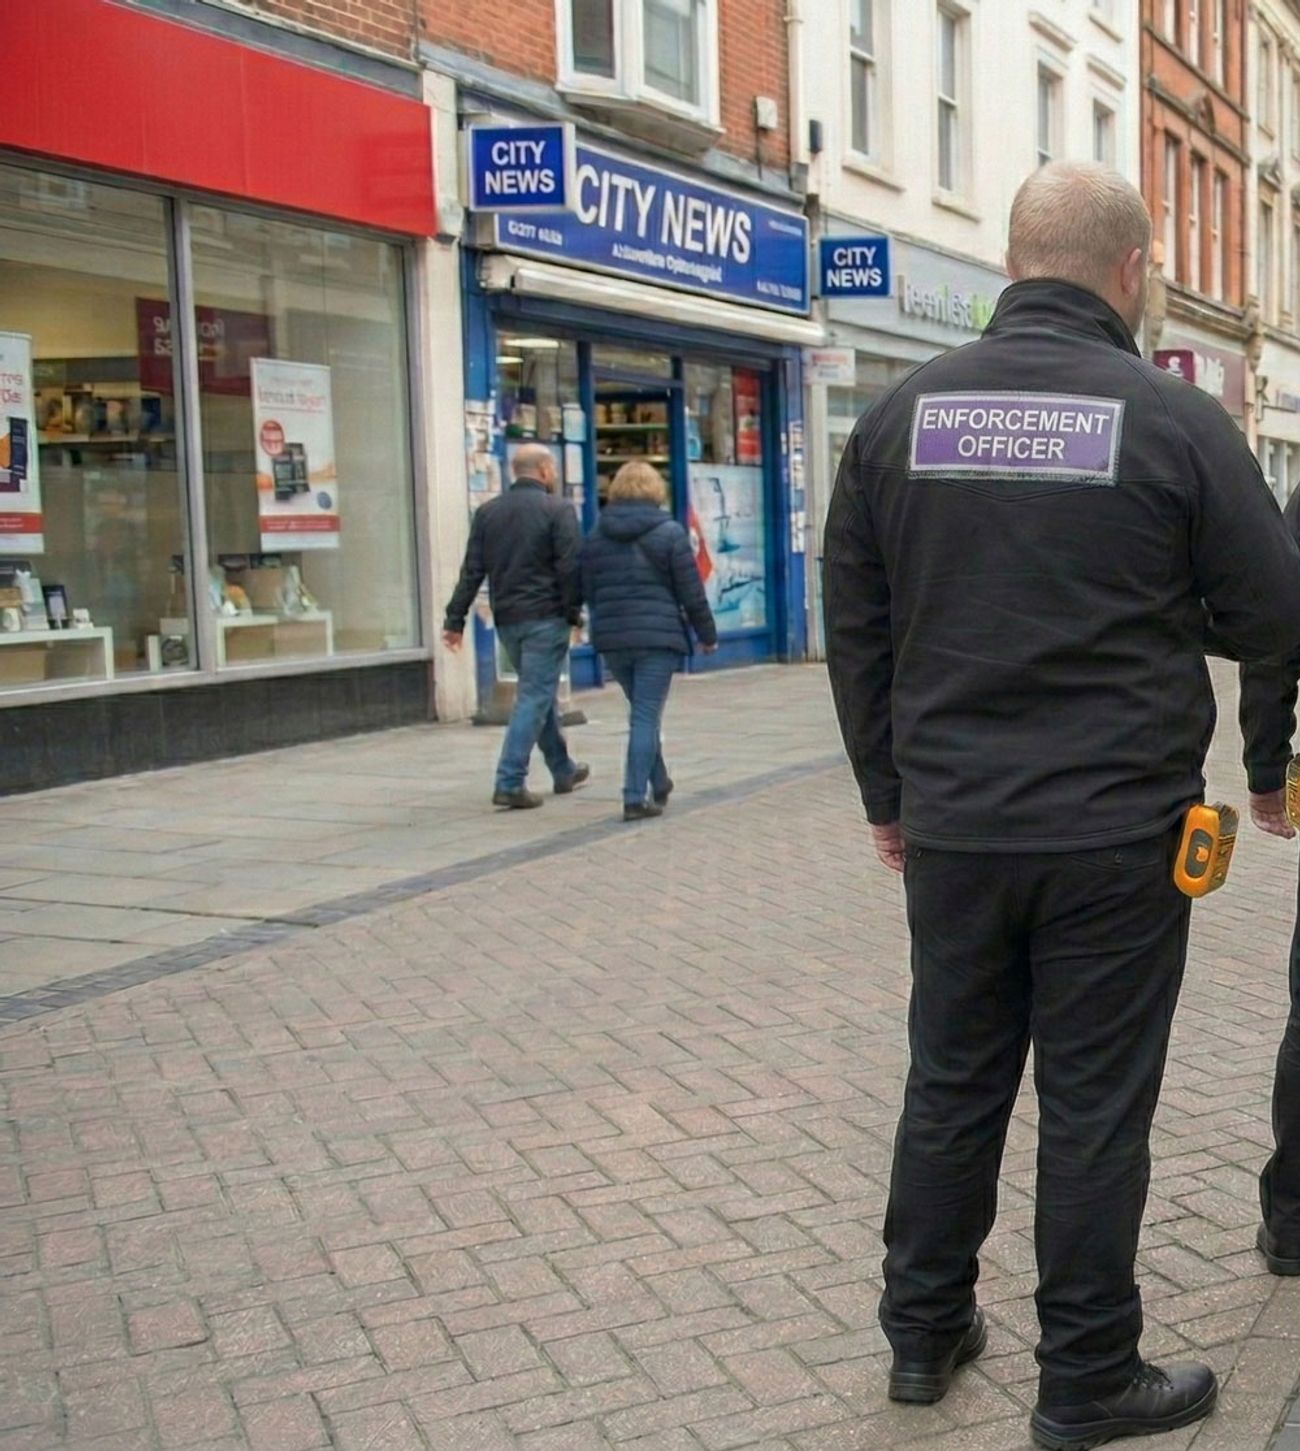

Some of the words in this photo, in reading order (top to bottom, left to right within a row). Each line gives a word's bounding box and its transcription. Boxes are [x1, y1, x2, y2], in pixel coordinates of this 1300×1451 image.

[491, 140, 546, 166] CITY
[484, 168, 556, 195] NEWS
[575, 164, 656, 238] CITY
[660, 189, 752, 264] NEWS
[833, 246, 877, 267] CITY
[826, 267, 883, 288] NEWS
[922, 408, 1110, 435] ENFORCEMENT
[957, 435, 1066, 460] OFFICER
